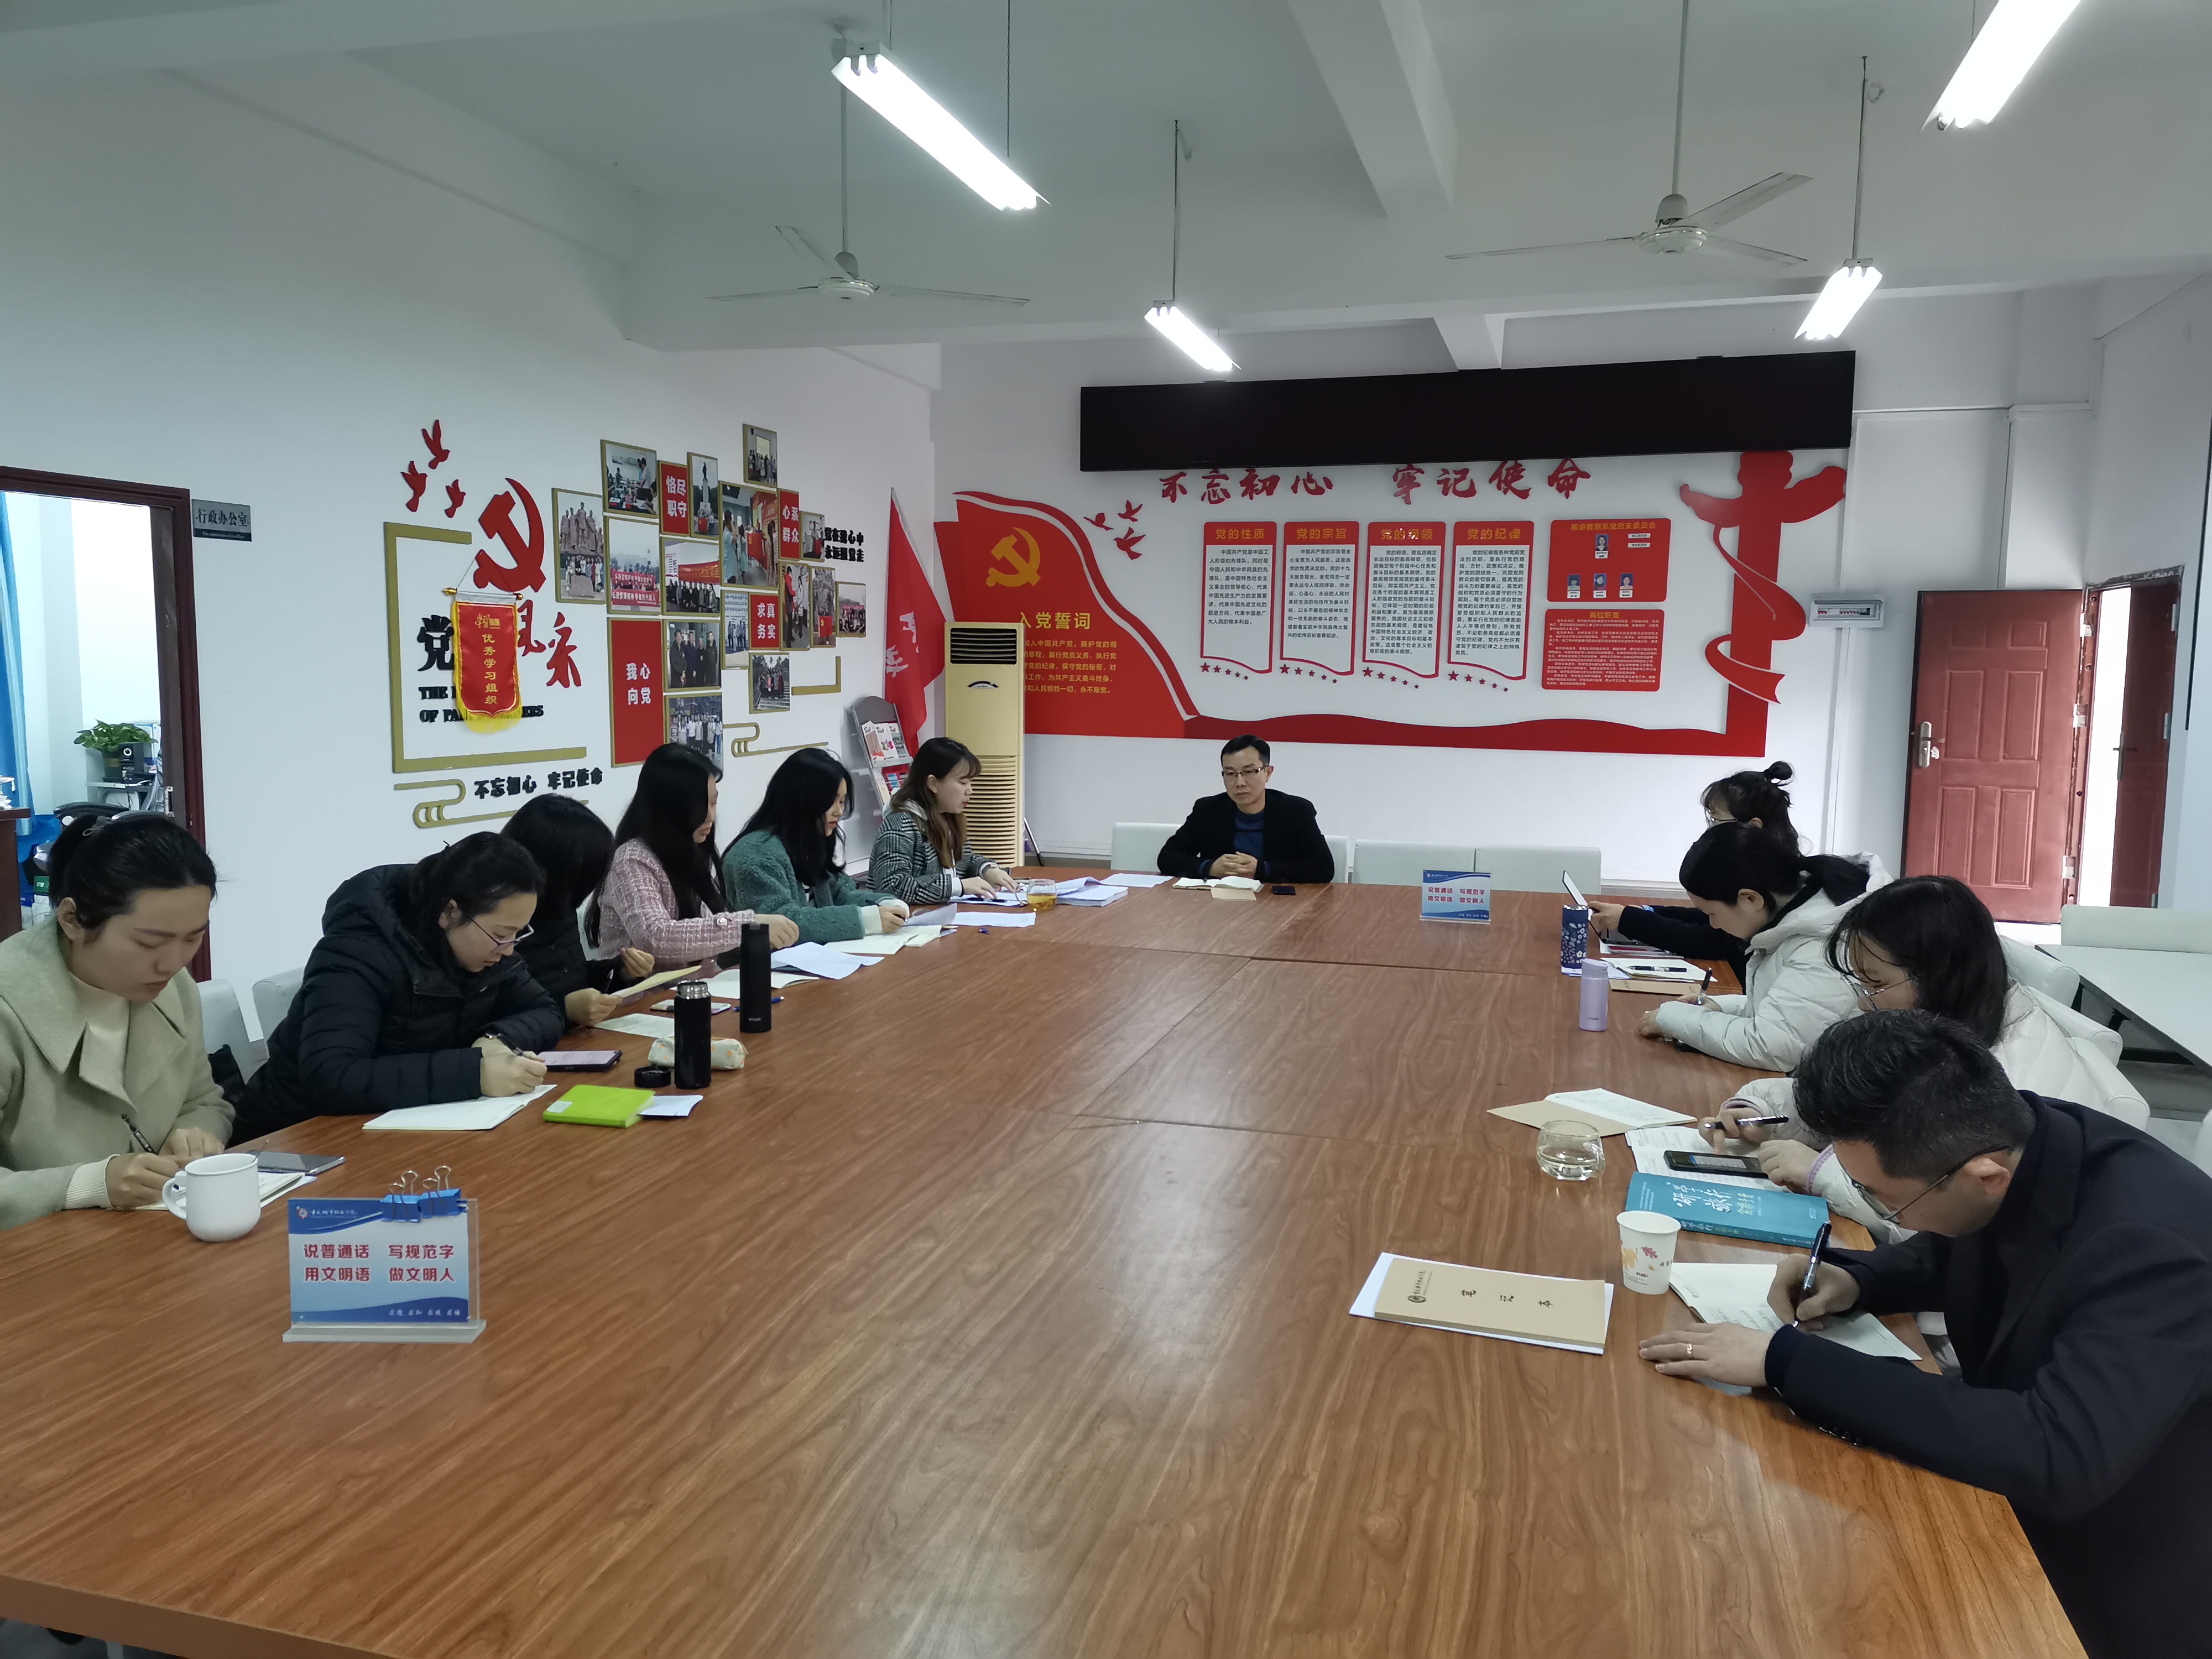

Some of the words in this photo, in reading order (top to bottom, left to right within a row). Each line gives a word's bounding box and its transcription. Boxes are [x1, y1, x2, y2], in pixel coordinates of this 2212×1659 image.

[666, 476, 686, 495] 恪尽
[1159, 467, 1333, 504] 不忘初心
[1392, 458, 1591, 505] 牢记使命
[667, 499, 687, 518] 职守
[782, 505, 799, 521] 心系
[198, 508, 248, 527] 行政办公室
[782, 527, 799, 543] 群众
[1215, 529, 1264, 539] 党的性质
[1297, 528, 1347, 539] 党的宗旨
[1381, 528, 1433, 540] 党的纲领
[1467, 528, 1521, 539] 党的纪律
[757, 603, 775, 618] 求真
[1020, 612, 1091, 629] 入党誓词
[757, 624, 775, 639] 务实
[481, 634, 498, 705] 优秀学习组织
[626, 662, 651, 681] 我心
[419, 686, 448, 700] THE
[628, 687, 651, 706] 向党
[419, 709, 439, 722] OF
[474, 775, 537, 799] 不忘初心
[547, 768, 603, 790] 牢记使命
[304, 1244, 369, 1259] 说普通话
[388, 1245, 455, 1259] 写规范字
[305, 1267, 370, 1282] 用文明语
[389, 1267, 455, 1282] 做文明人
